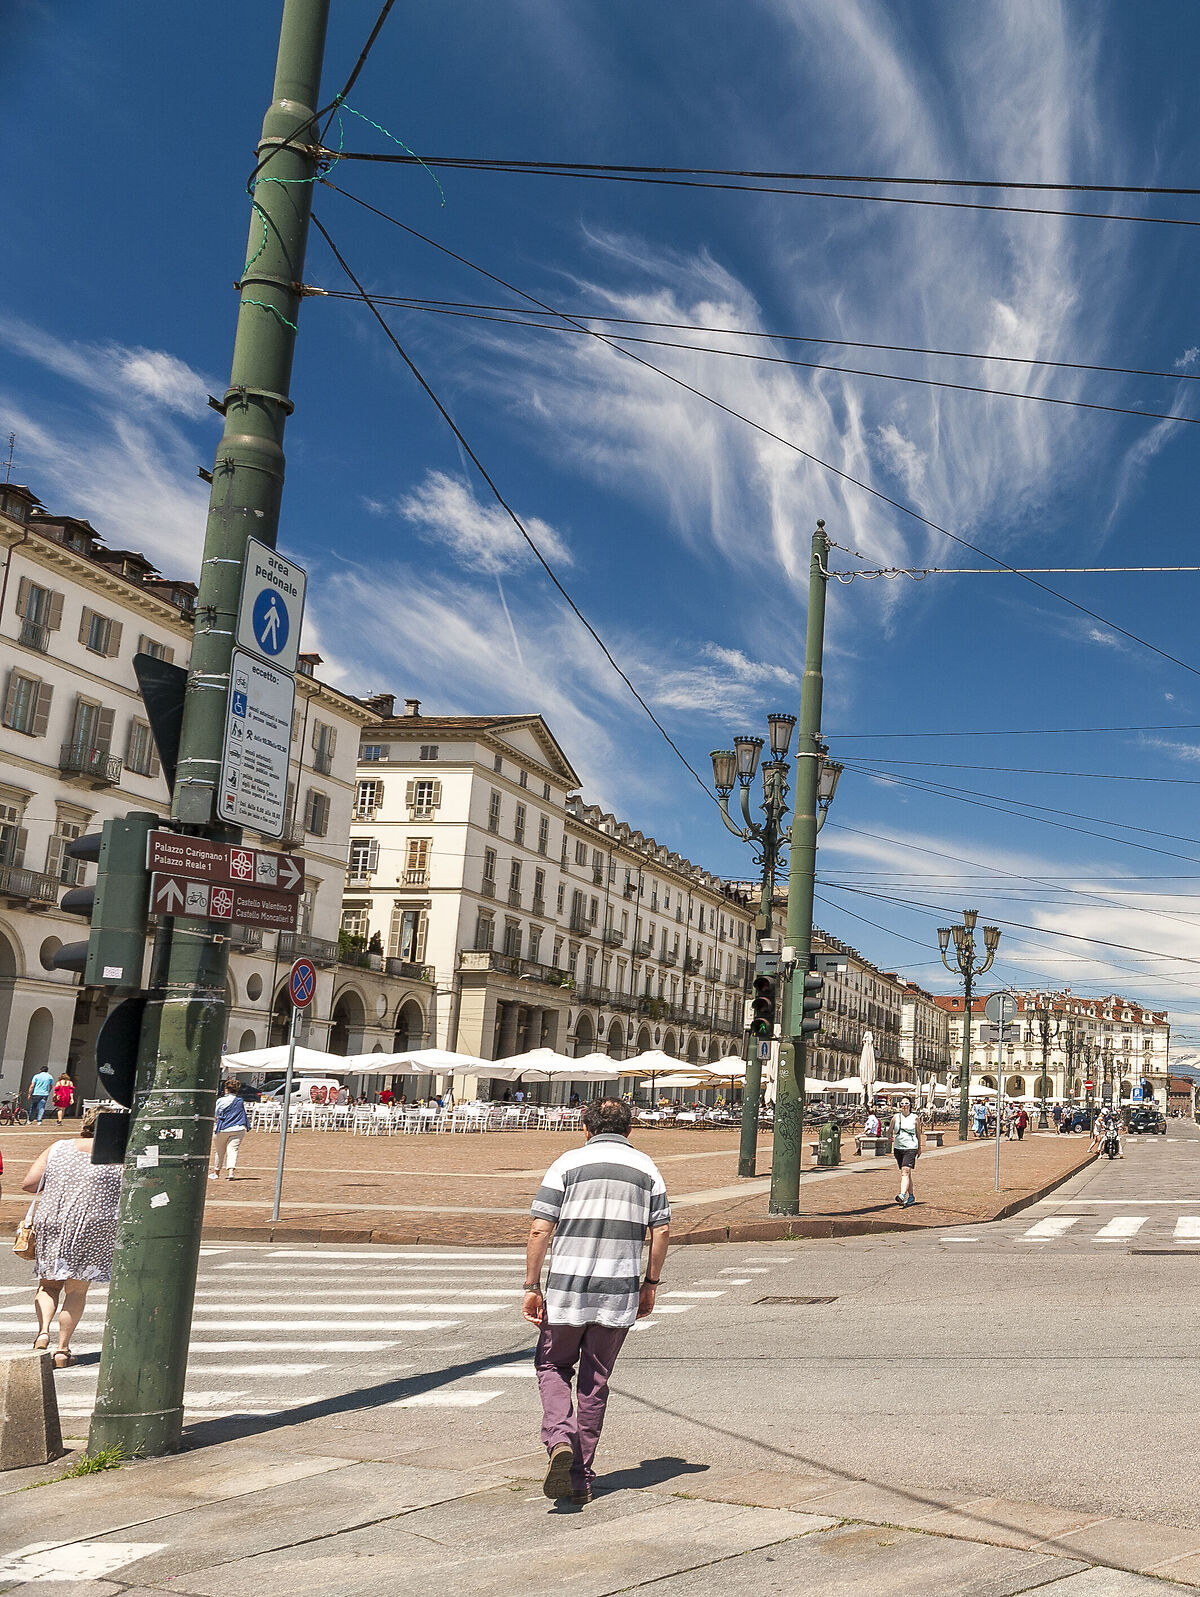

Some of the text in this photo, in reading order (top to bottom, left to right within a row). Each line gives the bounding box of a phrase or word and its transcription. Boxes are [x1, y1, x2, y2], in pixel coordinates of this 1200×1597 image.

[268, 557, 289, 577] area
[255, 564, 298, 597] pedonale
[252, 666, 280, 685] eccetto:
[155, 842, 184, 854] Palazzo
[186, 847, 223, 860] Carignano
[154, 854, 212, 871] Palazzo Reale 1
[236, 897, 293, 912] Castello Valentino 2
[235, 908, 260, 919] Castello
[260, 912, 289, 923] Moncalieri
